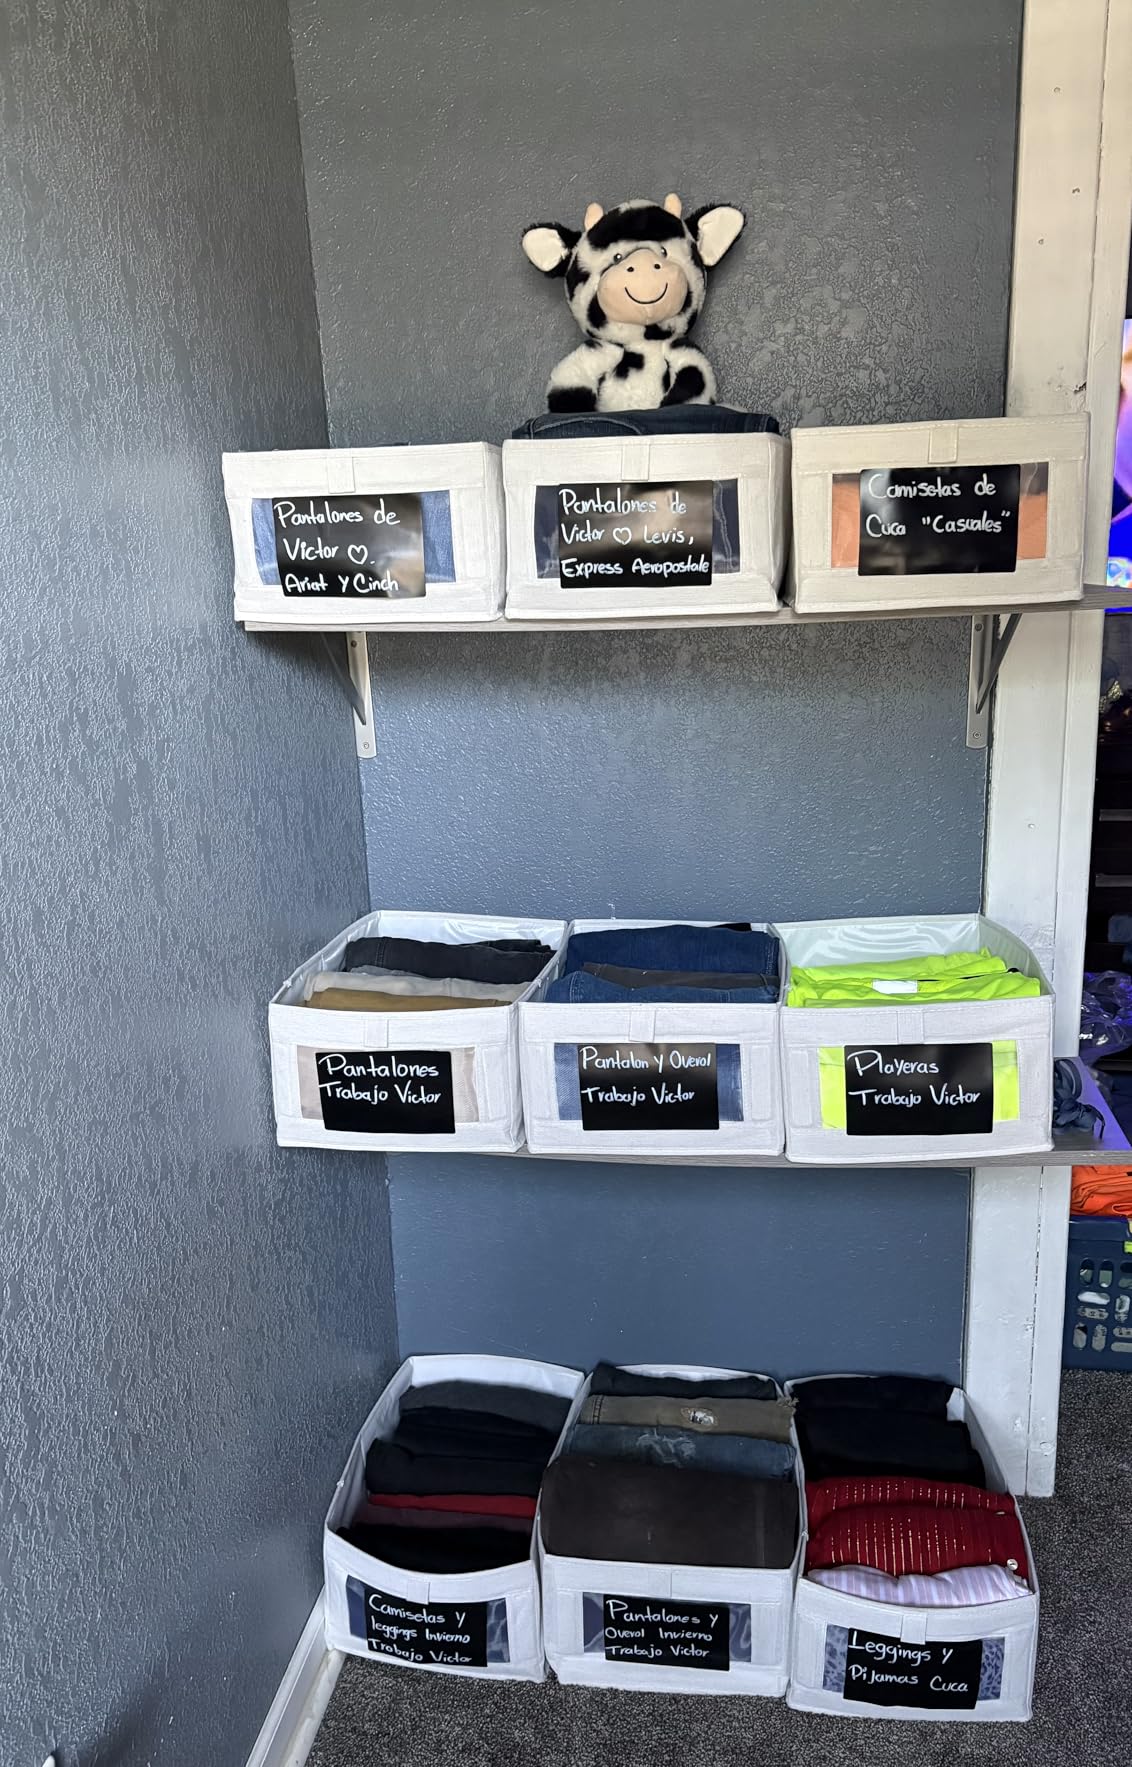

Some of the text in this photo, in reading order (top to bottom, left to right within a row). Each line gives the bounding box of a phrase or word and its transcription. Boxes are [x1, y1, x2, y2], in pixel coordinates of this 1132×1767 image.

[868, 473, 996, 499] Camisetas de
[273, 498, 400, 528] Pantalones de
[559, 488, 686, 515] Pantalones de
[561, 520, 604, 544] Victor
[866, 510, 1011, 538] Cuca "Casuales"
[283, 538, 339, 560] Victor
[561, 554, 709, 578] Express Aeropostale
[285, 573, 328, 593] Ariat
[353, 570, 399, 596] Cinch
[318, 1054, 439, 1077] Pantalones
[580, 1046, 649, 1069] Pantalon
[847, 1050, 940, 1076] Playeras
[318, 1080, 441, 1105] Trabajo Victor
[581, 1082, 695, 1107] Trabajo Victor
[848, 1083, 981, 1107] Trabajo Victor
[369, 1594, 445, 1624] Camisetas
[606, 1600, 700, 1623] Pantalones
[659, 1628, 712, 1641] Invierno
[368, 1638, 472, 1663] Trabajo Victor
[606, 1643, 710, 1658] Trabajo Victor
[848, 1631, 931, 1667] Leggings
[930, 1676, 968, 1692] Cuca
